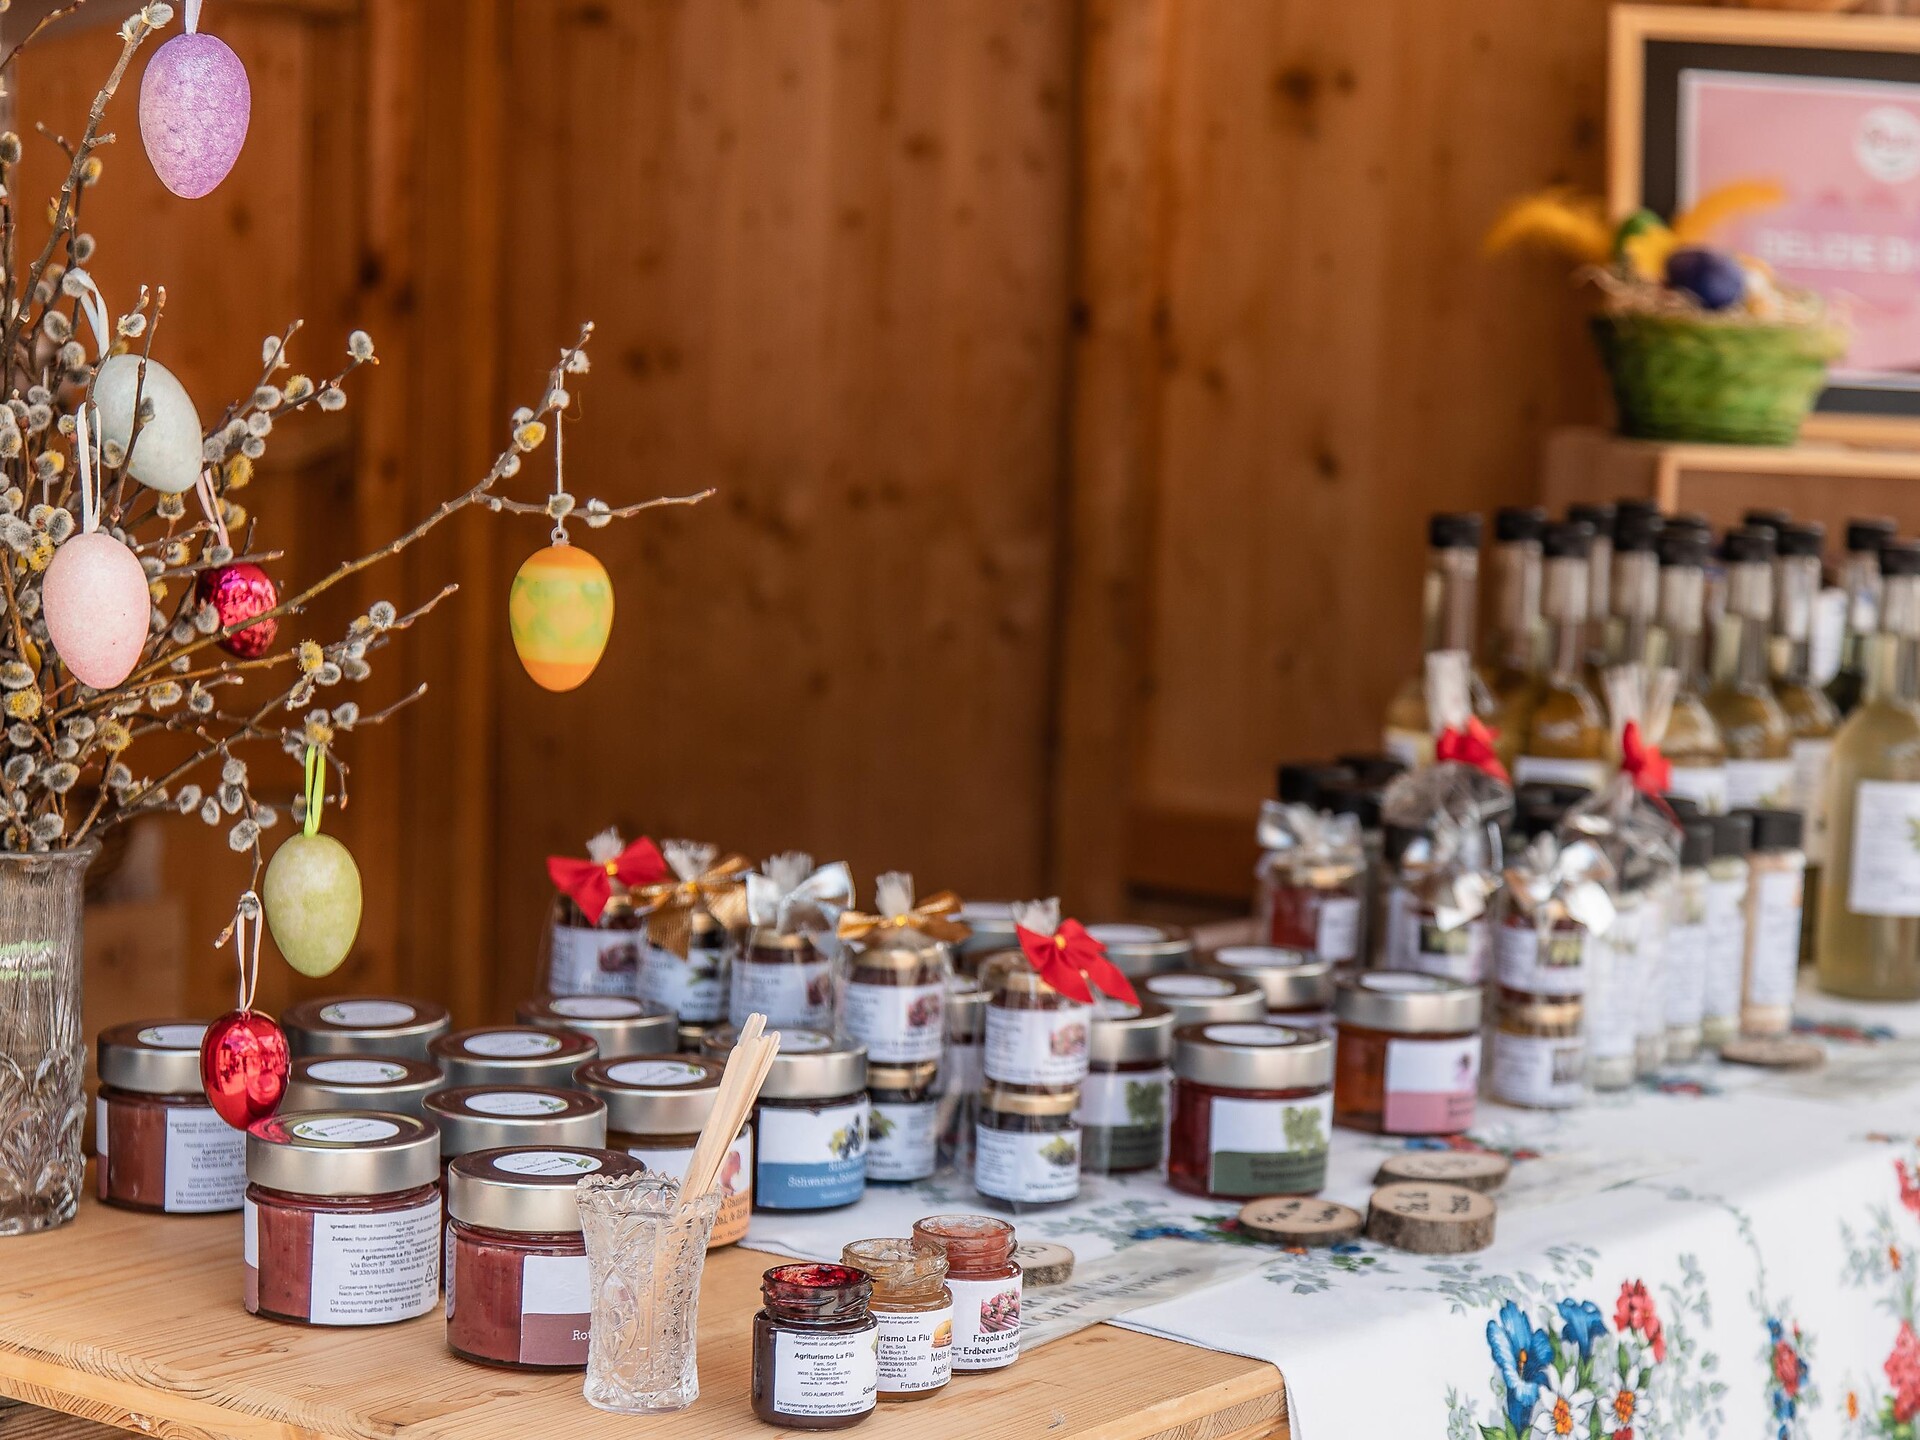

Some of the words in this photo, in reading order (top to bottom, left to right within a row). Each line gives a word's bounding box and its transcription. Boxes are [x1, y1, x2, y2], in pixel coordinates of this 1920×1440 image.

[973, 1334, 1000, 1344] Fragola
[964, 1346, 997, 1355] Erdbeere
[930, 1351, 946, 1362] Mela
[932, 1363, 947, 1376] Apfel
